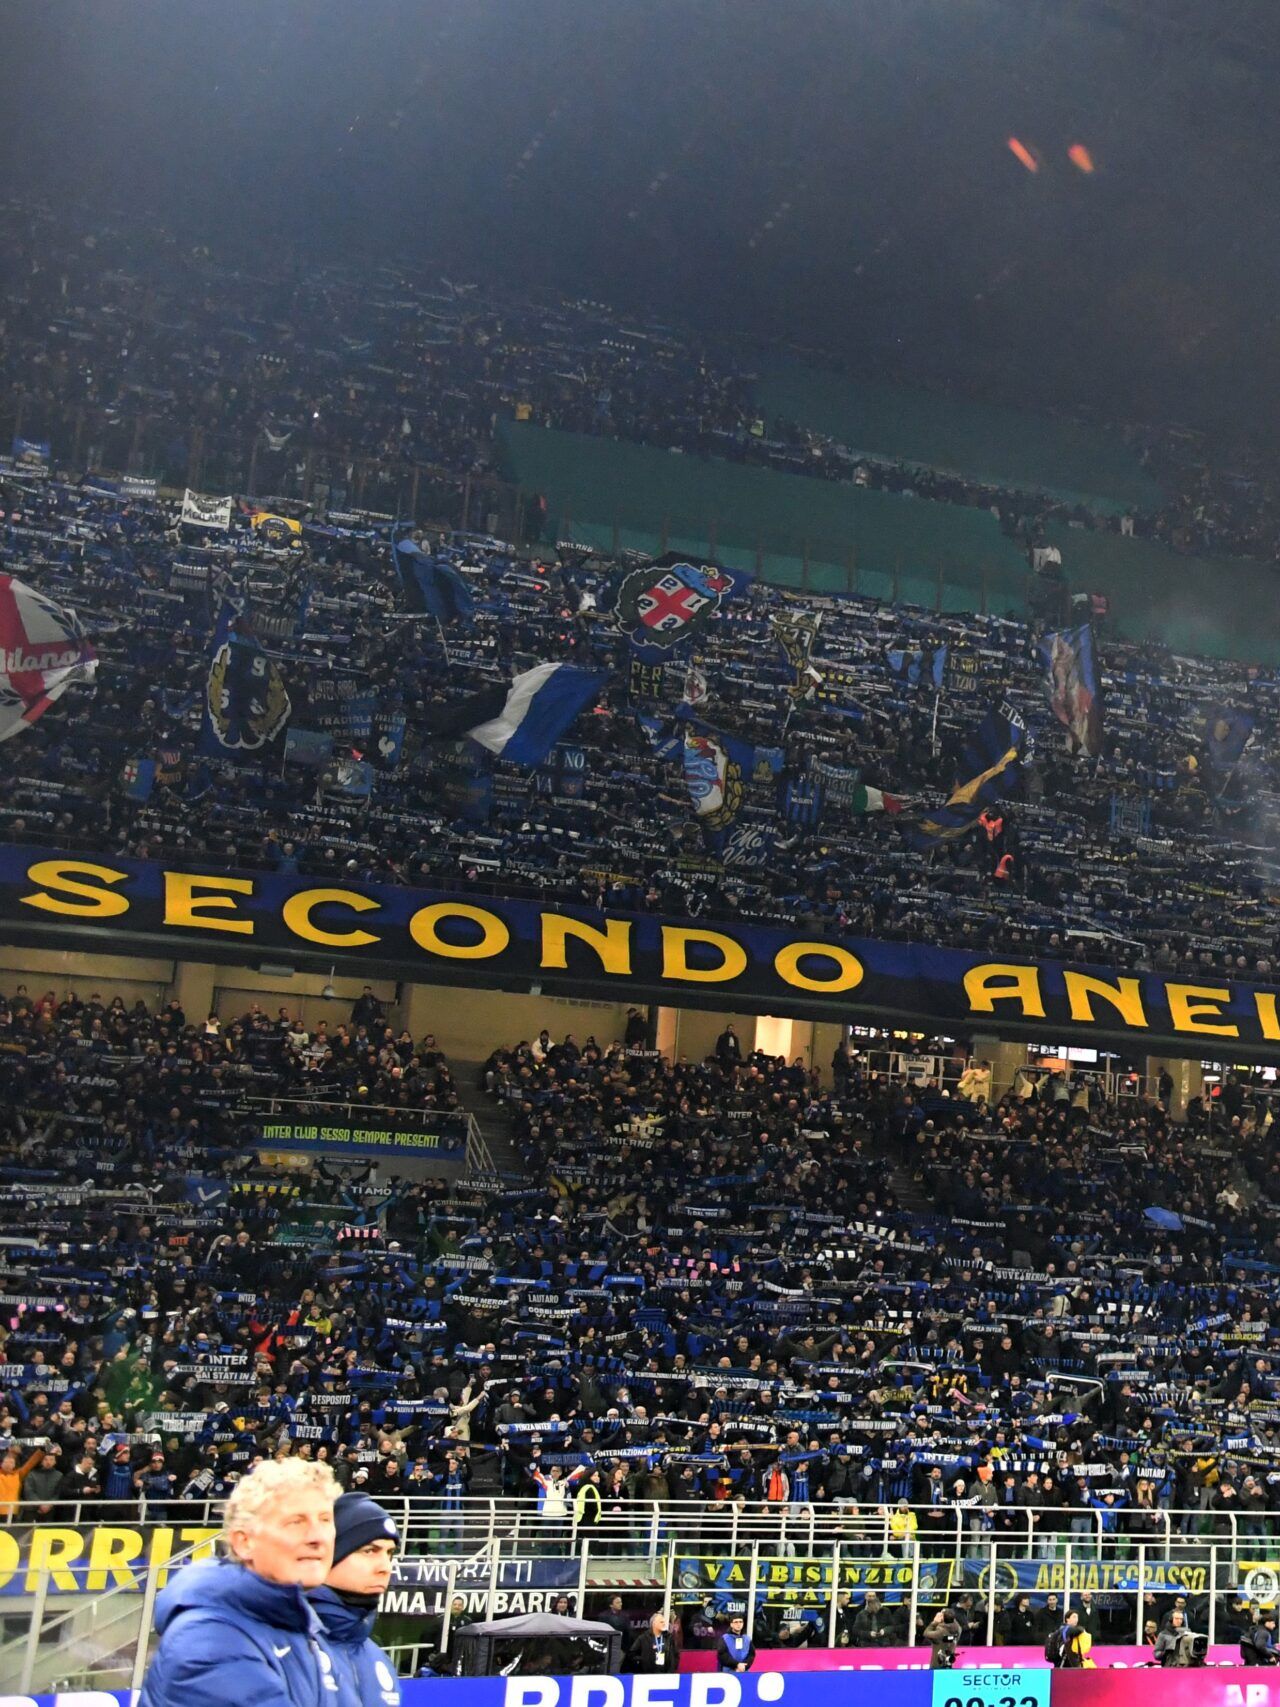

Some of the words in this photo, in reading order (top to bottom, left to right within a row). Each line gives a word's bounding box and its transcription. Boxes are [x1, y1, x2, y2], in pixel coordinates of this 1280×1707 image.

[319, 715, 372, 725] TRADIRLA
[565, 752, 584, 769] NO
[20, 859, 864, 993] SECONDO
[626, 1048, 643, 1056] FORZA
[727, 1111, 753, 1120] INTER
[263, 1125, 291, 1138] INTER
[294, 1126, 317, 1139] CLUB
[320, 1128, 350, 1140] SESSO
[353, 1130, 392, 1145] SEMPRE
[394, 1133, 440, 1148] PRESENTI
[608, 1137, 653, 1149] MILANO
[367, 1187, 392, 1196] AMO
[726, 1280, 743, 1290] INTER
[237, 1292, 256, 1303] INTER
[528, 1294, 559, 1304] LAUTARO
[210, 1355, 248, 1366] INTER
[212, 1372, 237, 1380] STATI
[311, 1395, 351, 1405] P.ESPOSITO
[836, 1394, 852, 1402] INTER
[927, 1405, 942, 1414] INTER
[296, 1425, 323, 1439] INTER
[515, 1423, 534, 1432] FORZA
[534, 1422, 552, 1431] INTER
[213, 1433, 234, 1441] INTER
[1042, 1441, 1056, 1450] INTER
[1227, 1438, 1248, 1450] INTER
[846, 1445, 863, 1454] INTER
[232, 1452, 250, 1461] INTER
[922, 1452, 958, 1462] INTER
[882, 1460, 897, 1469] INTER
[1137, 1467, 1166, 1479] LAUTARO
[417, 1560, 532, 1583] MORATTI
[704, 1563, 913, 1584] VALBISENZIO
[1035, 1563, 1206, 1596] ABBIATEGRASSO
[767, 1586, 852, 1602] PRAT
[963, 1674, 1021, 1687] SECTOR
